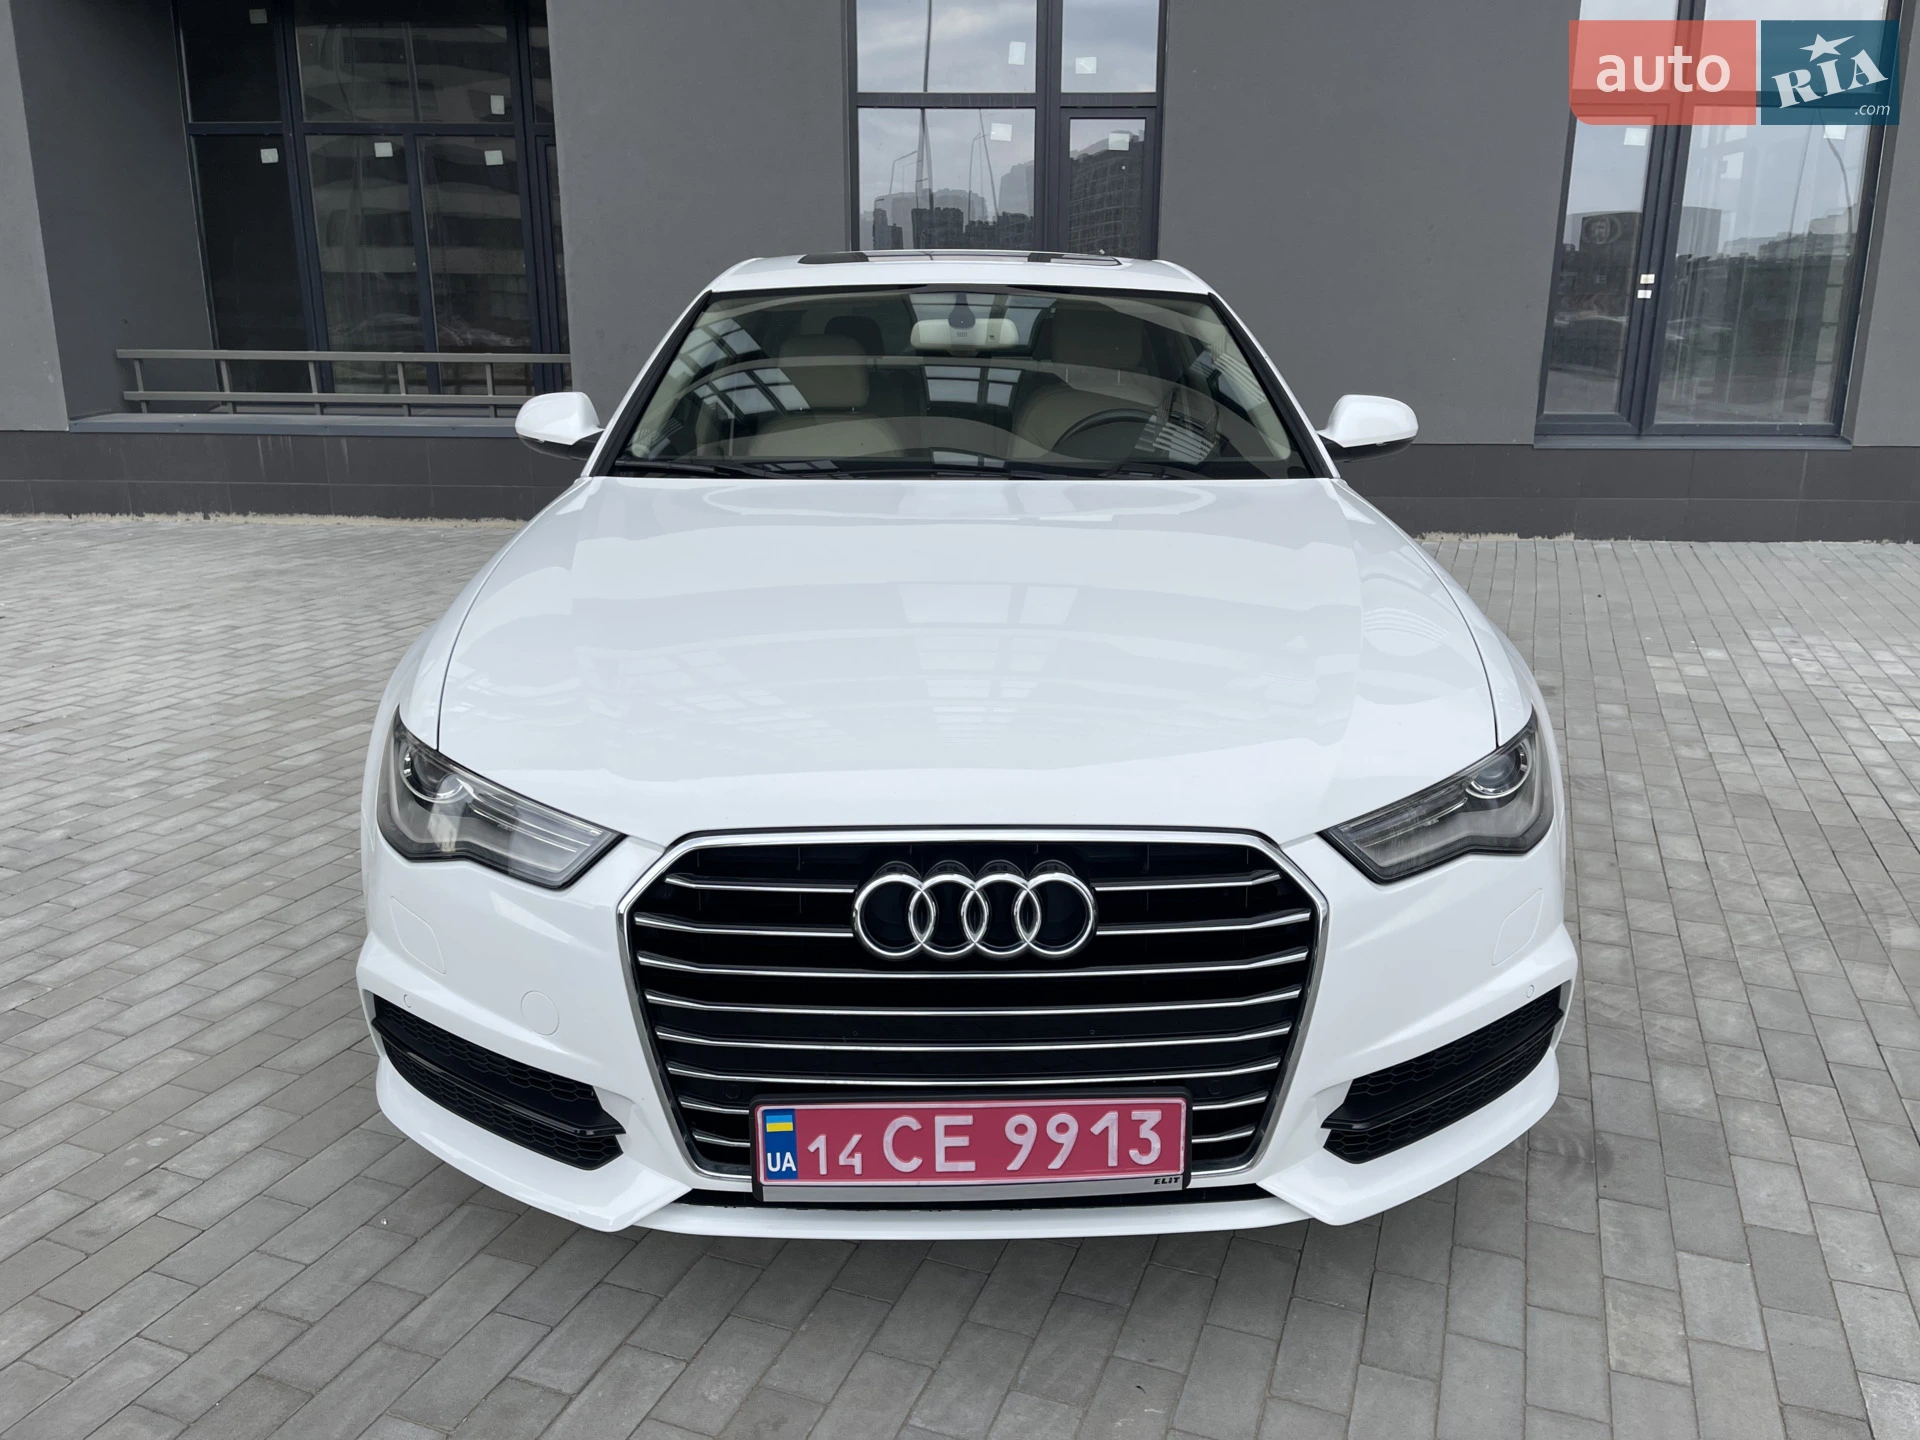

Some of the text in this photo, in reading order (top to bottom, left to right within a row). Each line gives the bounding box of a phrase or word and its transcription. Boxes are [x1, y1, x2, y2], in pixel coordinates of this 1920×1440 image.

[767, 1152, 797, 1172] UA
[807, 1110, 1163, 1176] 14 CE 9913
